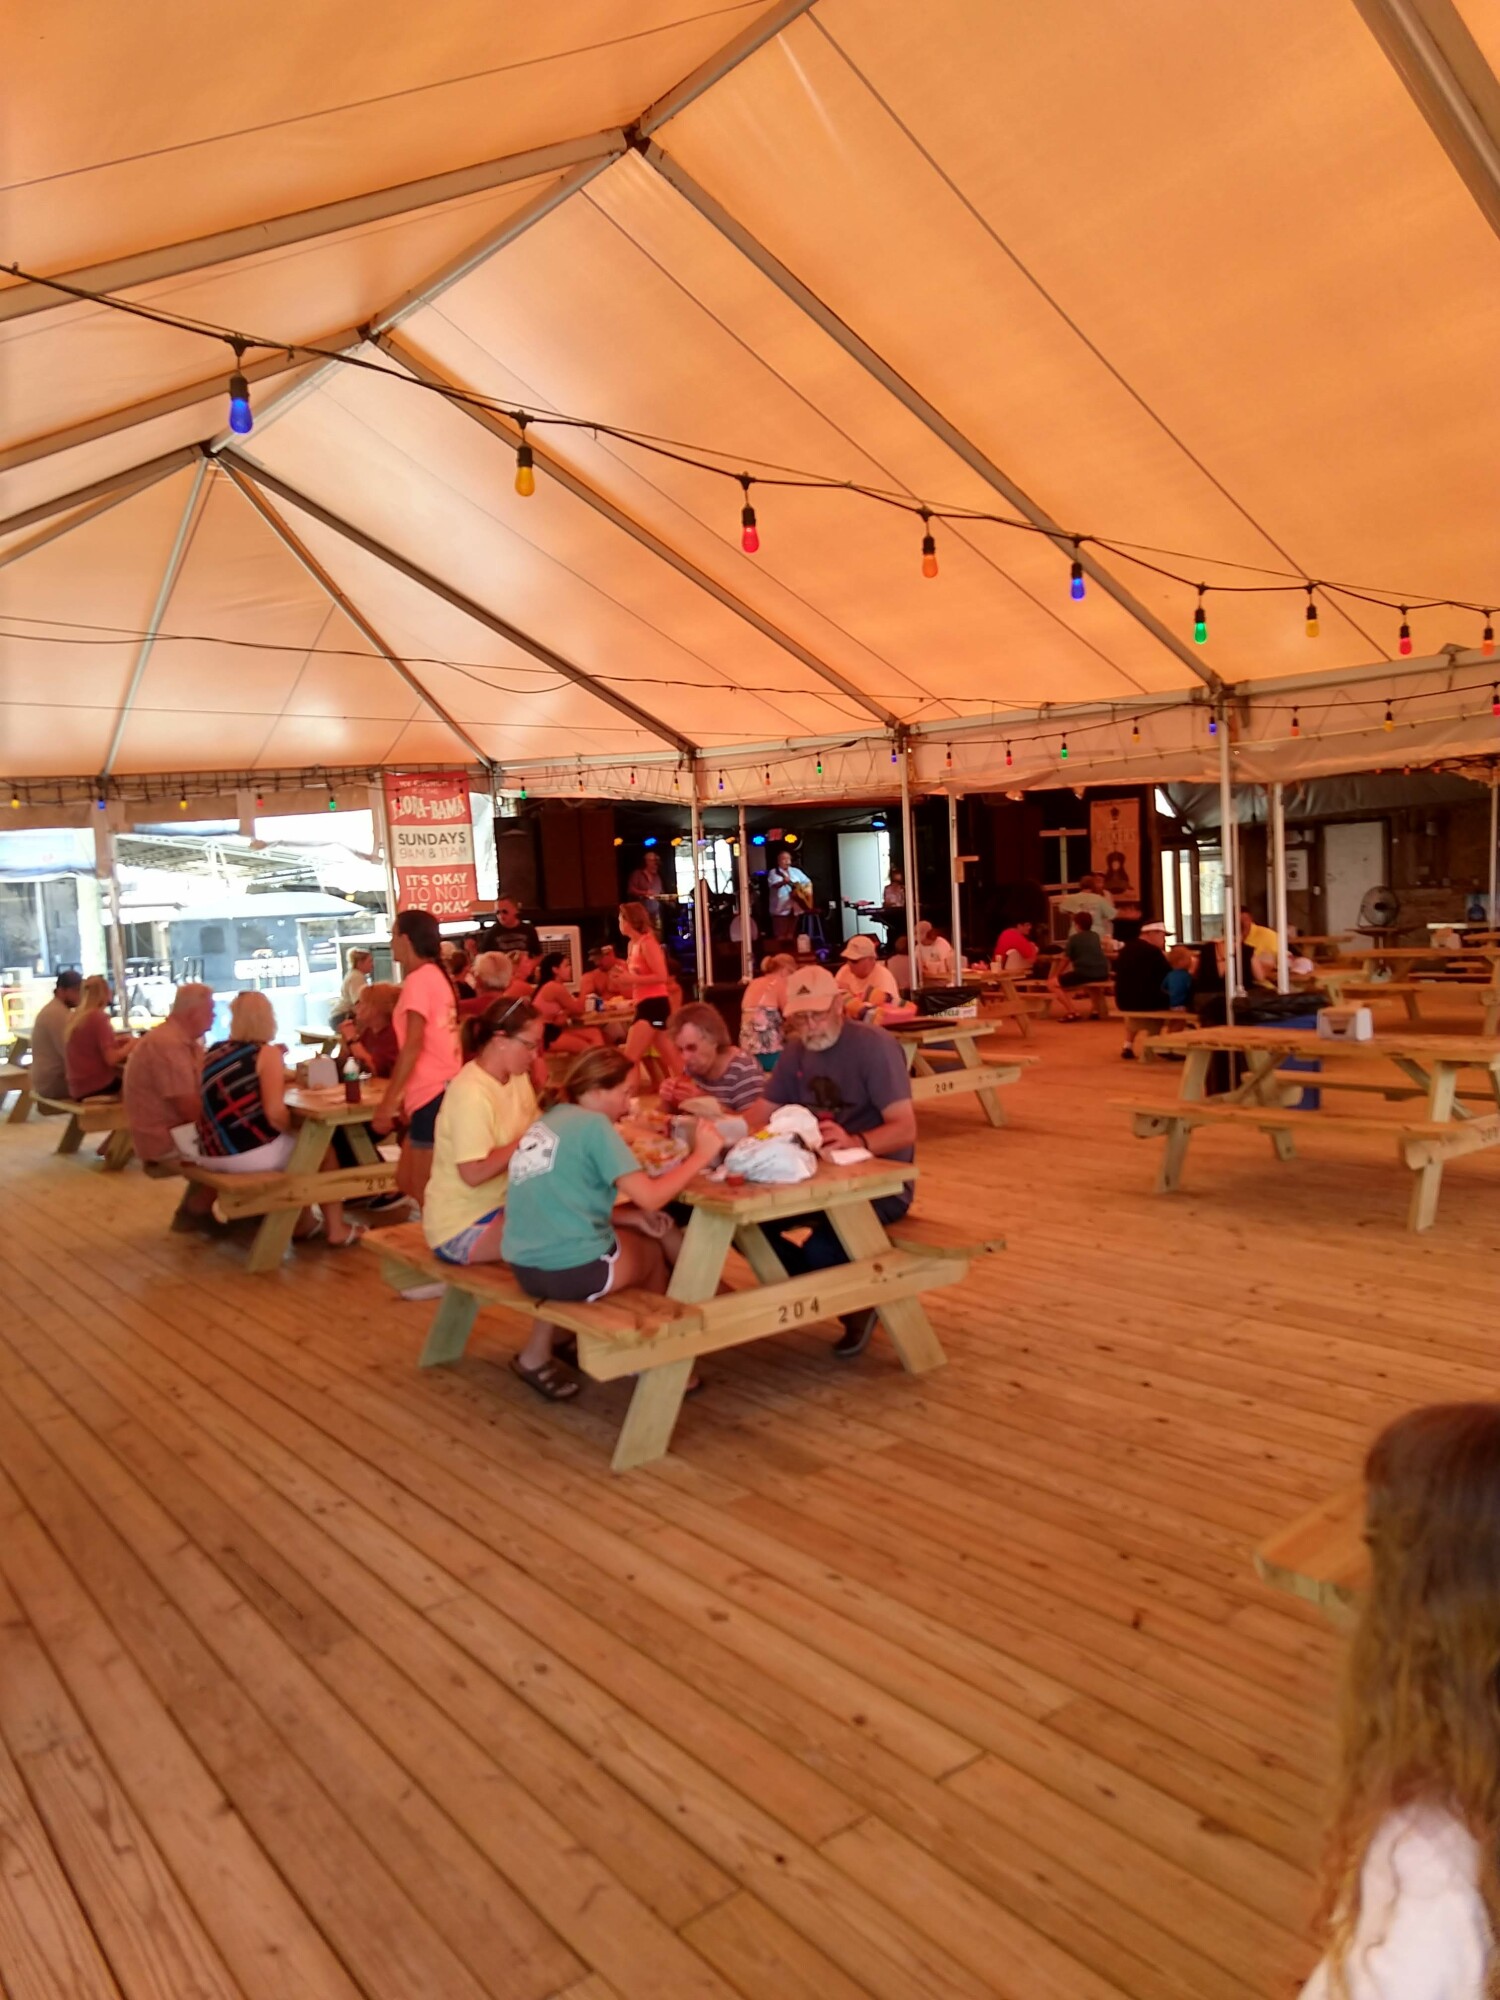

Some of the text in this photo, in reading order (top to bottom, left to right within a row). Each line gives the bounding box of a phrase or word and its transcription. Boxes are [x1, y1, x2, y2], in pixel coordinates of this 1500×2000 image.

[398, 832, 466, 846] SUNDAYS
[406, 872, 468, 886] IT'S OKAY
[407, 884, 468, 902] TO NOT
[432, 900, 470, 915] OKAY
[778, 1296, 820, 1324] 204
